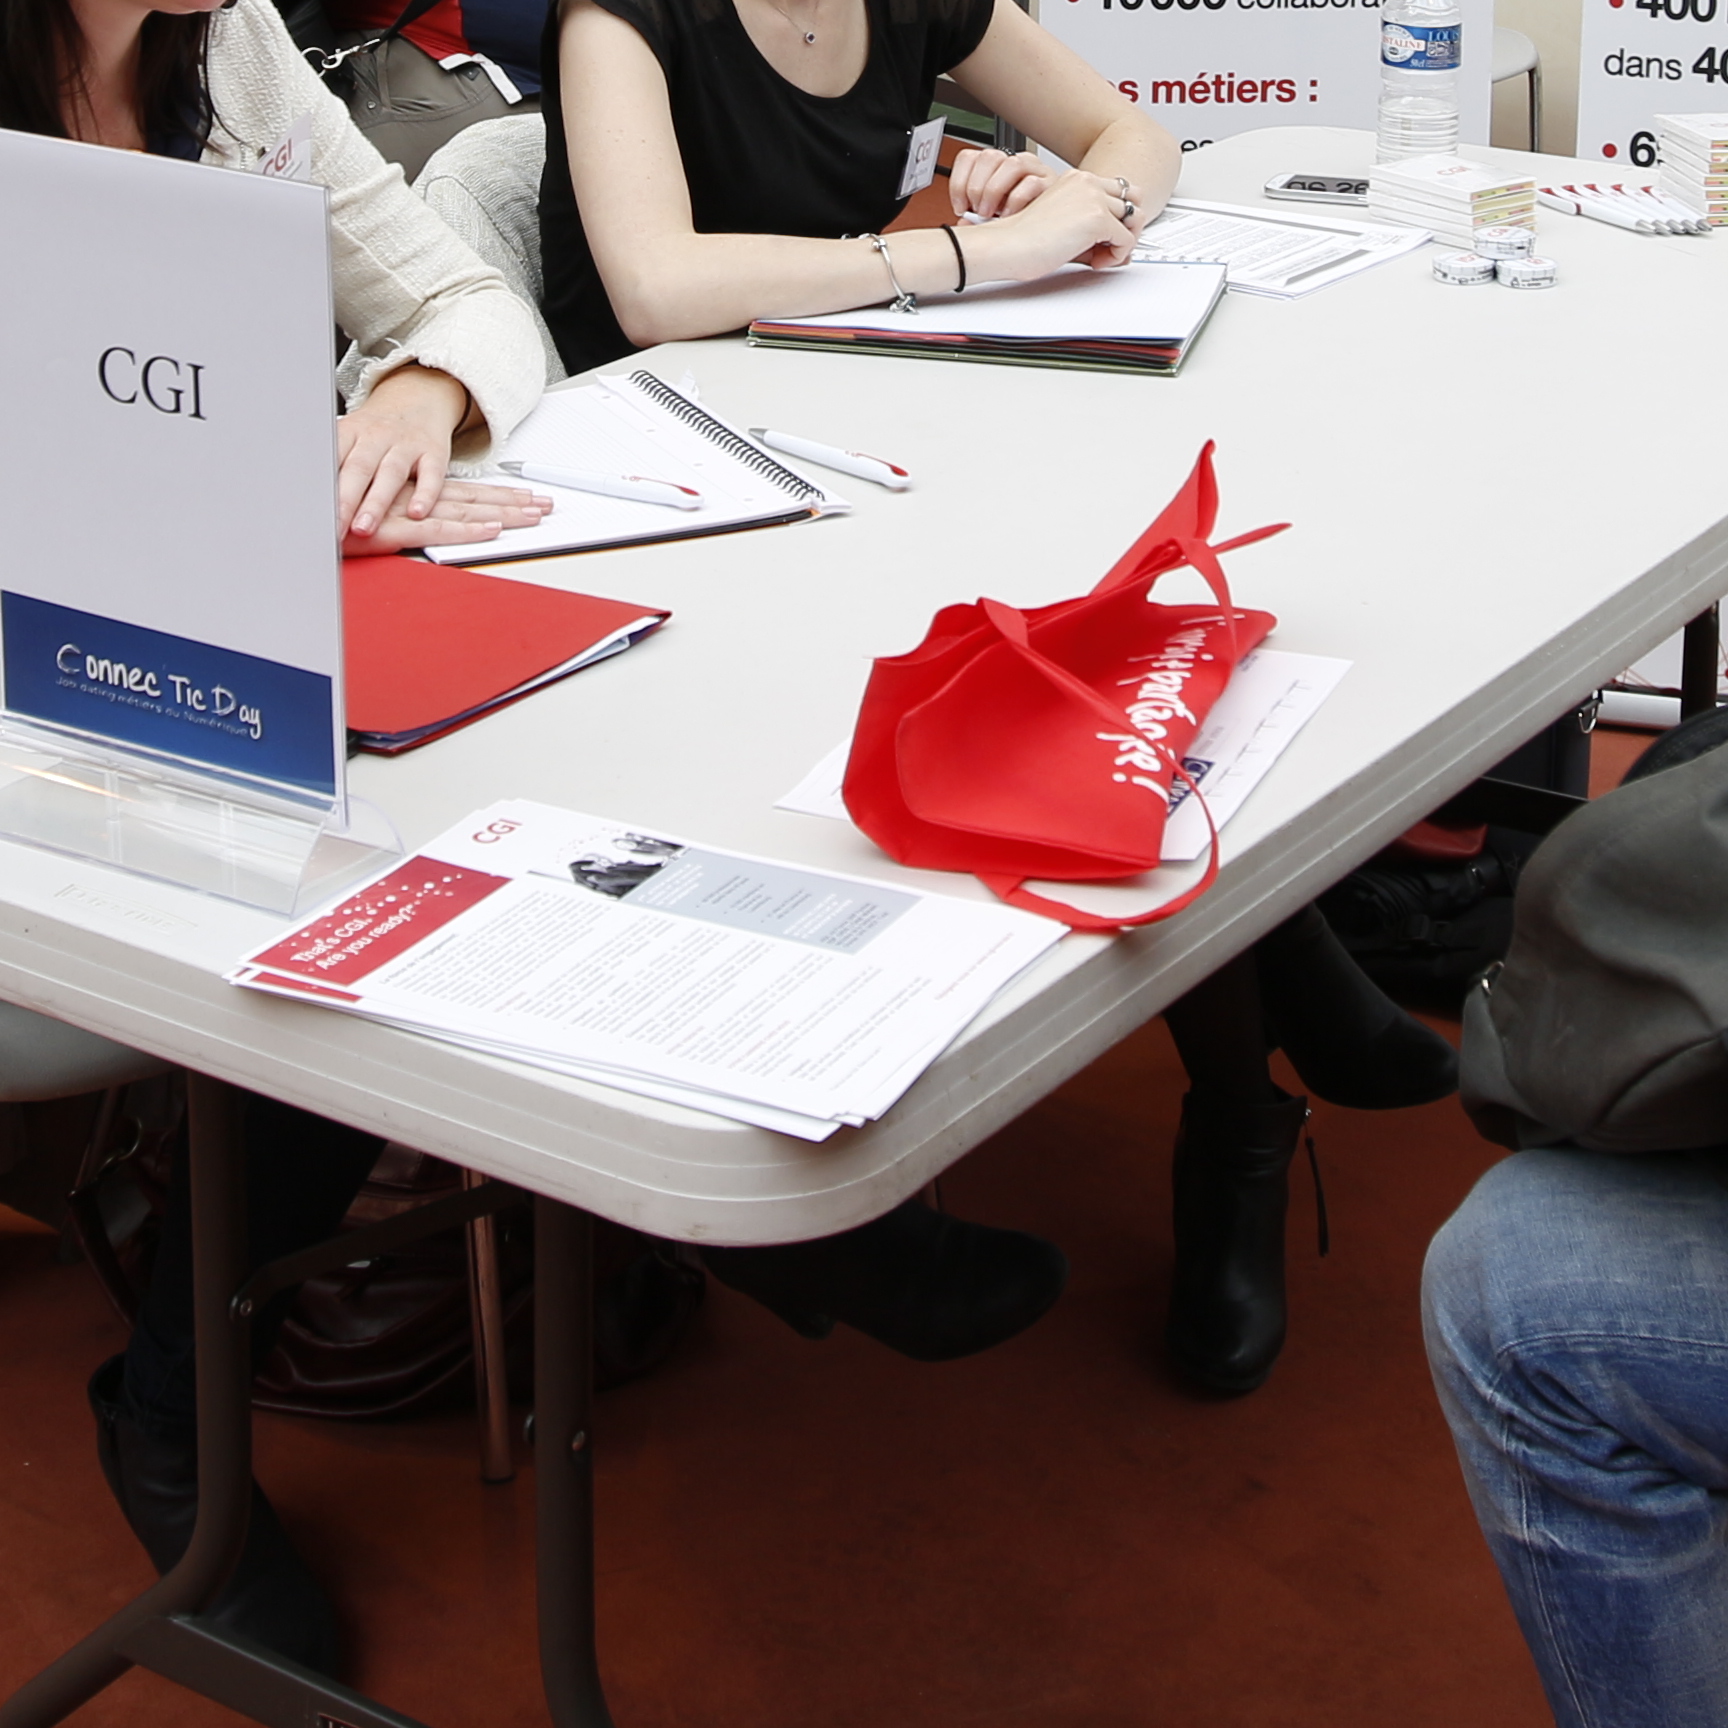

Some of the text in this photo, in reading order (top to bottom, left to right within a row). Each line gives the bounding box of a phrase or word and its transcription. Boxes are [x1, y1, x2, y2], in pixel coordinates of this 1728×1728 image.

[1604, 48, 1682, 81] dans
[1152, 73, 1296, 104] métiers
[96, 345, 207, 421] CGI
[56, 644, 161, 697] Connec
[211, 684, 262, 740] Day
[472, 817, 523, 845] CGI
[316, 953, 346, 970] Are
[342, 937, 372, 955] you
